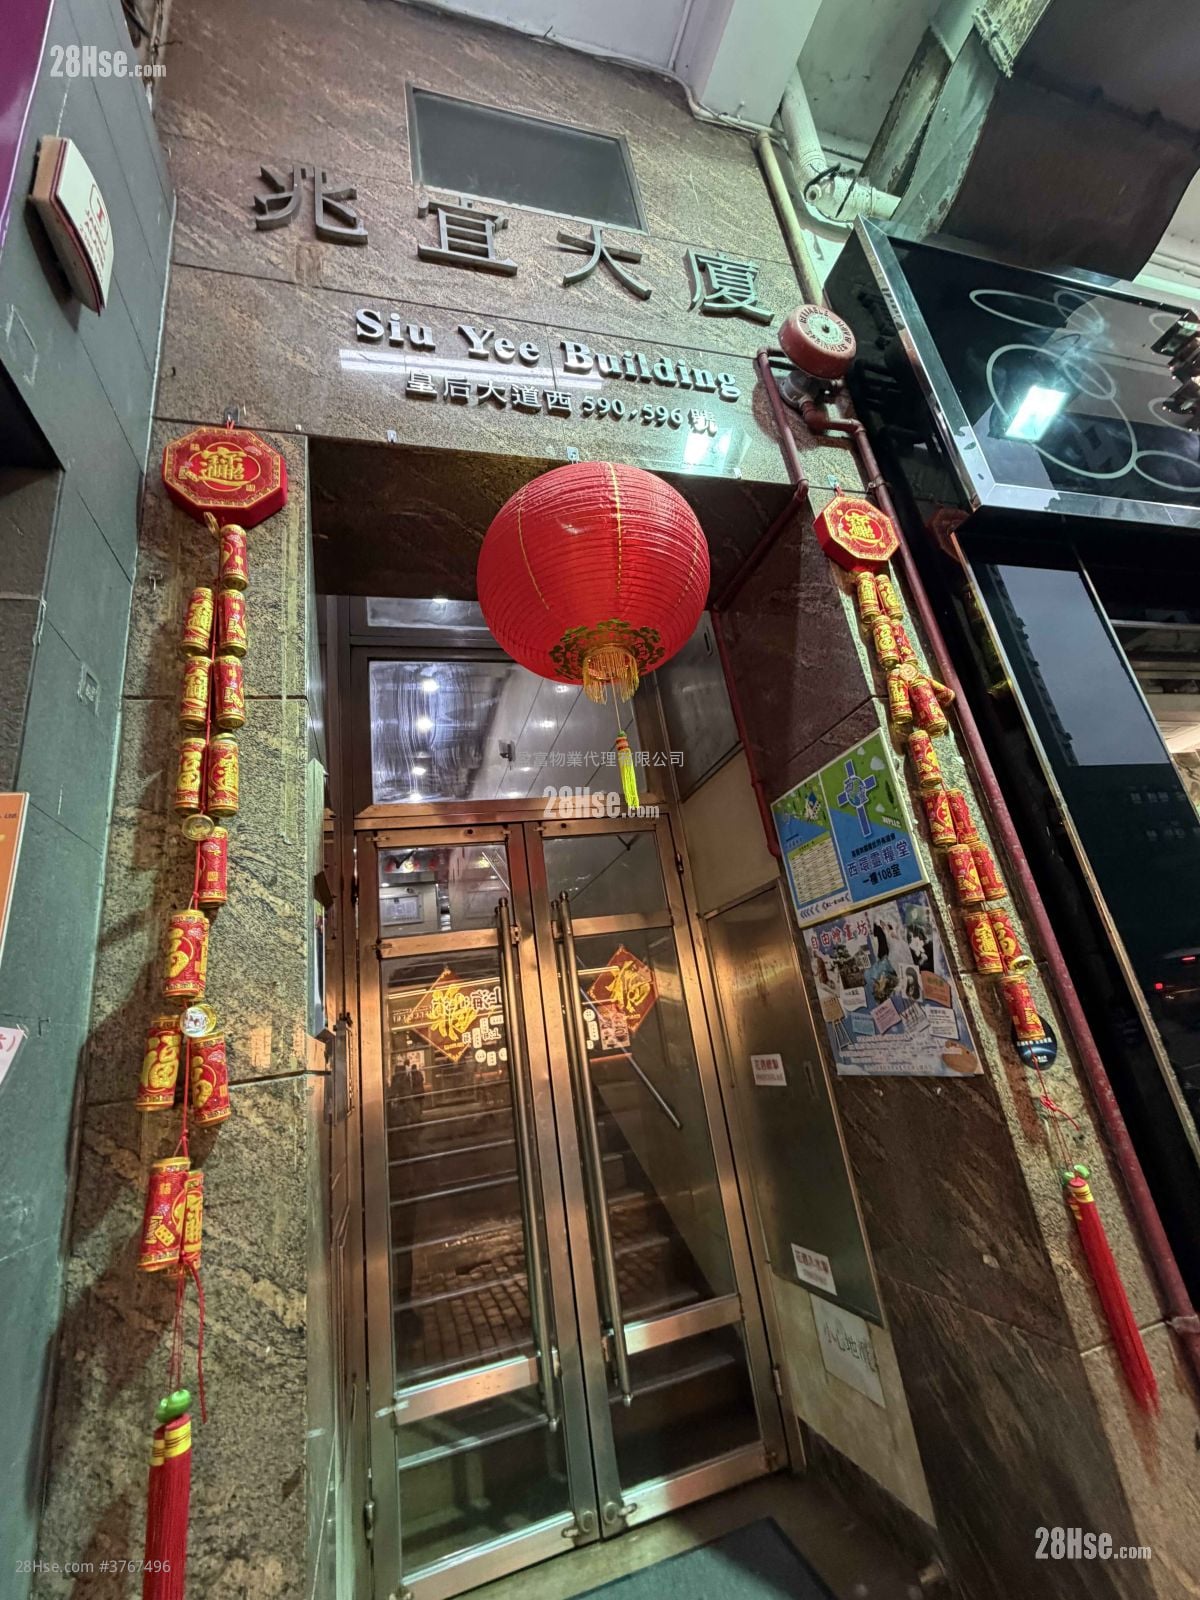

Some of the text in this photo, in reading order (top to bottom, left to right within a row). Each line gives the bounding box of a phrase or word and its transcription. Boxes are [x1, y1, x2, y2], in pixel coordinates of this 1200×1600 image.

[254, 165, 776, 326] 兆宜大廈
[356, 308, 742, 402] Siu Yee Building
